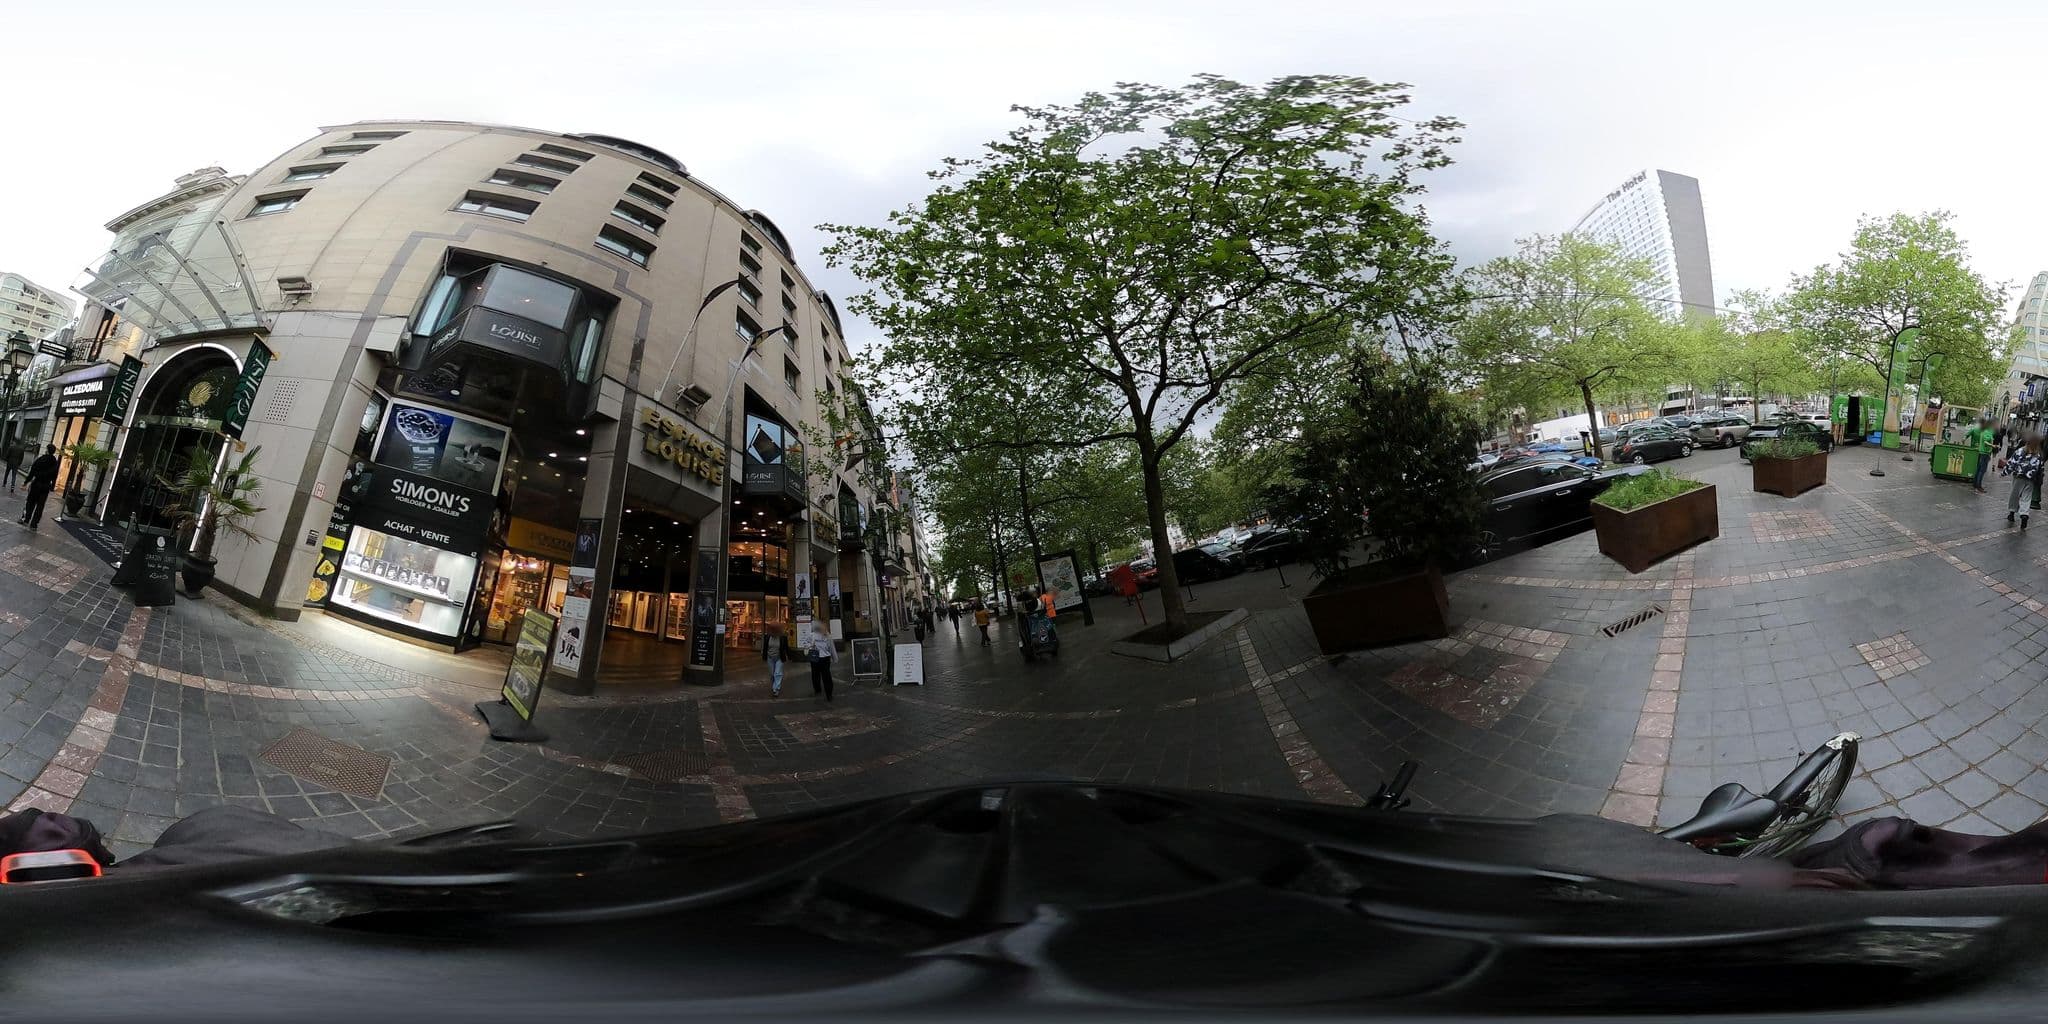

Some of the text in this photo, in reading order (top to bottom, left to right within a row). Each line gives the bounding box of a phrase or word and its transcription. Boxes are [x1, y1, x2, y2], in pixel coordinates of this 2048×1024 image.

[1606, 171, 1647, 203] The Hotel
[491, 323, 542, 347] LOUISE
[63, 380, 103, 396] CALZEDONIA
[640, 406, 727, 466] ESPACE
[643, 431, 723, 487] LOUISE
[391, 478, 471, 513] SIMON'S
[395, 495, 427, 508] HORLOGER
[431, 505, 460, 517] JOAILLIER
[384, 519, 415, 534] ACHAT
[420, 529, 450, 544] VENTE
